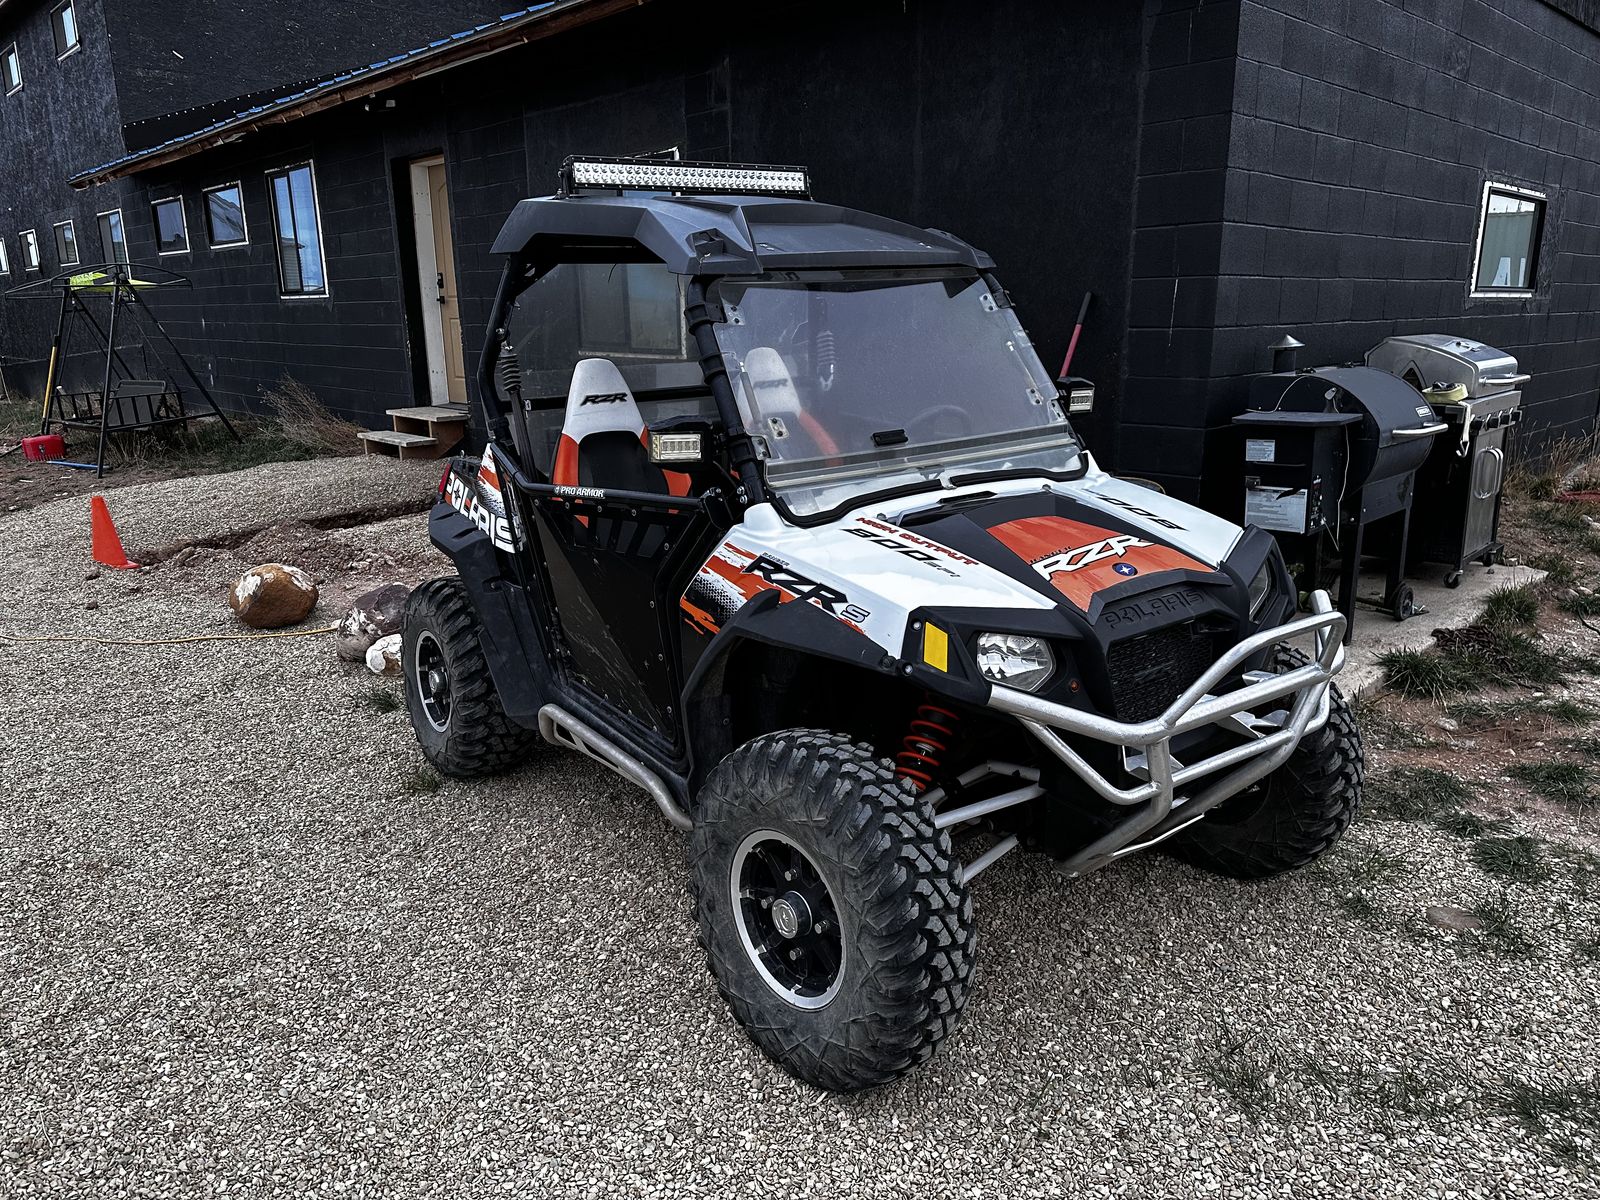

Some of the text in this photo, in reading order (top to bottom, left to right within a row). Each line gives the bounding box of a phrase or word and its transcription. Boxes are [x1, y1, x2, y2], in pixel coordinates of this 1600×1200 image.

[580, 392, 628, 406] RZR
[560, 485, 605, 498] PRO ARMOR
[840, 528, 942, 561] 800
[856, 517, 979, 565] HIGH OUTPUT
[1031, 535, 1155, 582] RZR
[741, 554, 871, 624] RZR S
[1100, 588, 1205, 630] POLARIS
